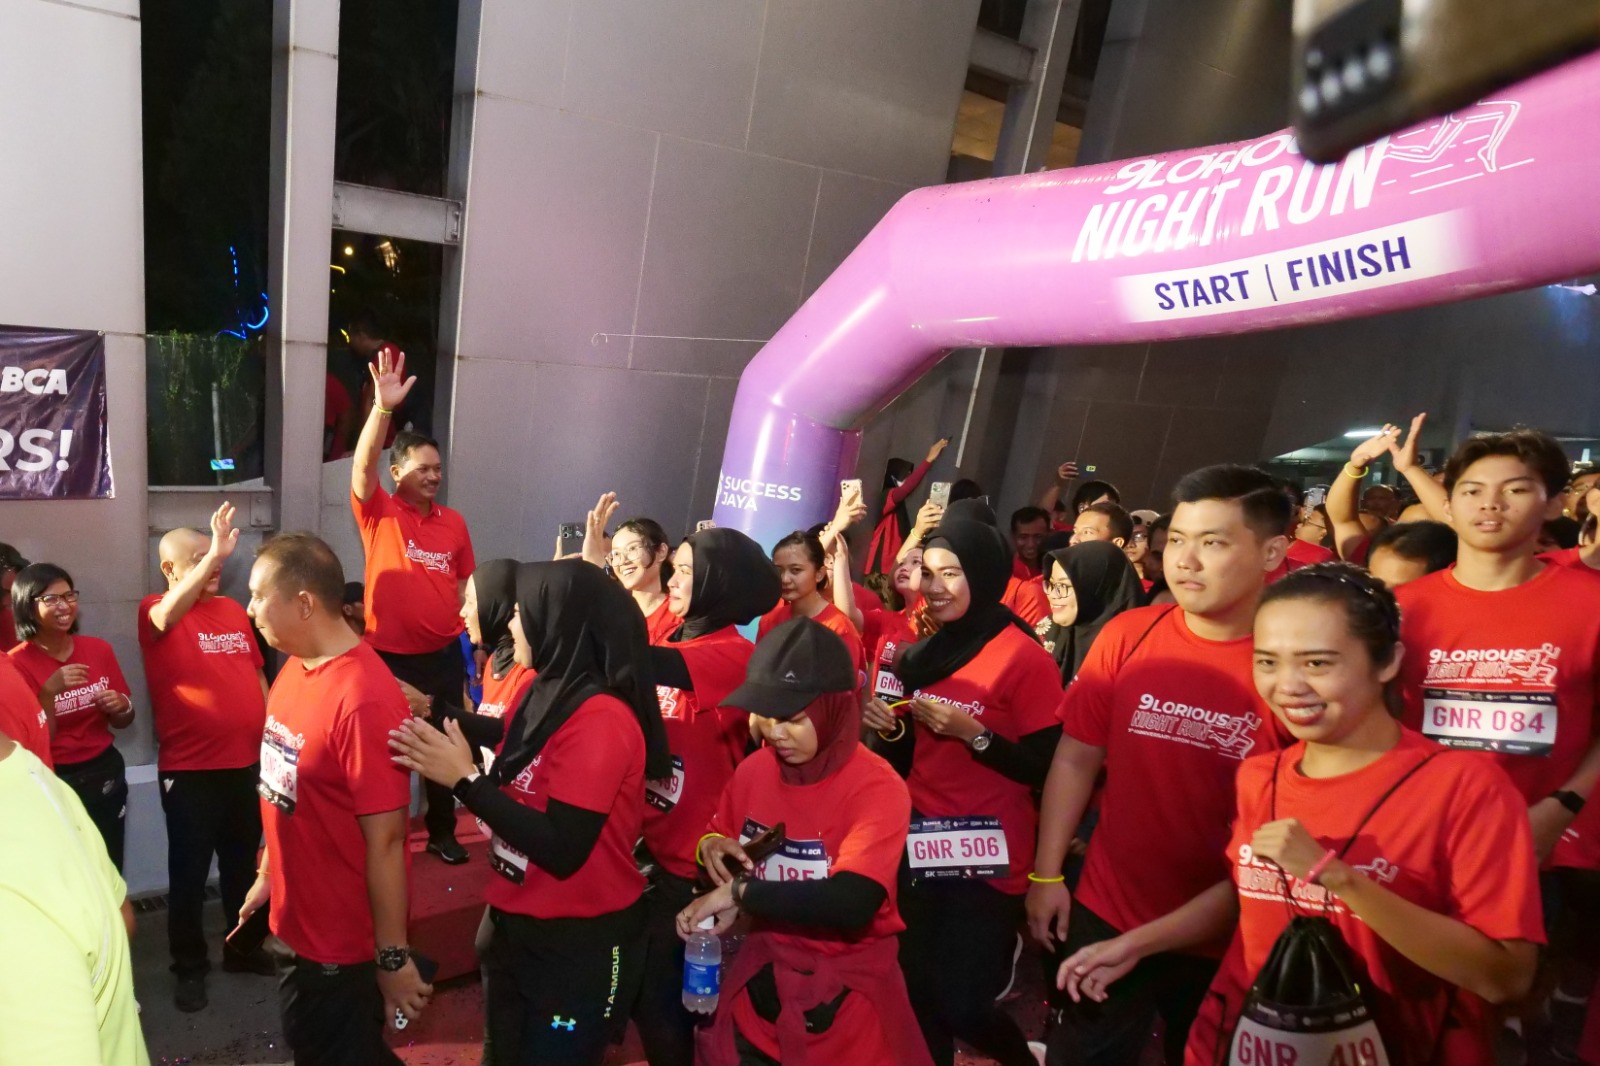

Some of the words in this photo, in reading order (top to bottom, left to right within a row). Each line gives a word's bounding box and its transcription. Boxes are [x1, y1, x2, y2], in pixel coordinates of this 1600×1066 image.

[1071, 177, 1242, 263] NIGHT
[1240, 135, 1391, 237] RUN
[1154, 270, 1250, 311] START
[1287, 235, 1411, 291] FINISH
[1, 366, 68, 395] BCA
[721, 492, 758, 511] JAYA
[724, 476, 802, 501] SUCCESS
[1429, 648, 1527, 663] 9LORIOUS
[1138, 693, 1231, 727] 9LORIOUS
[1432, 706, 1483, 730] GNR
[1492, 710, 1546, 734] 084
[1130, 710, 1179, 734] NIGHT
[1176, 718, 1212, 741] RUN
[913, 838, 954, 861] GNR
[959, 836, 1000, 858] 506
[607, 945, 620, 1005] ARMOUR
[1238, 1030, 1297, 1066] GNR
